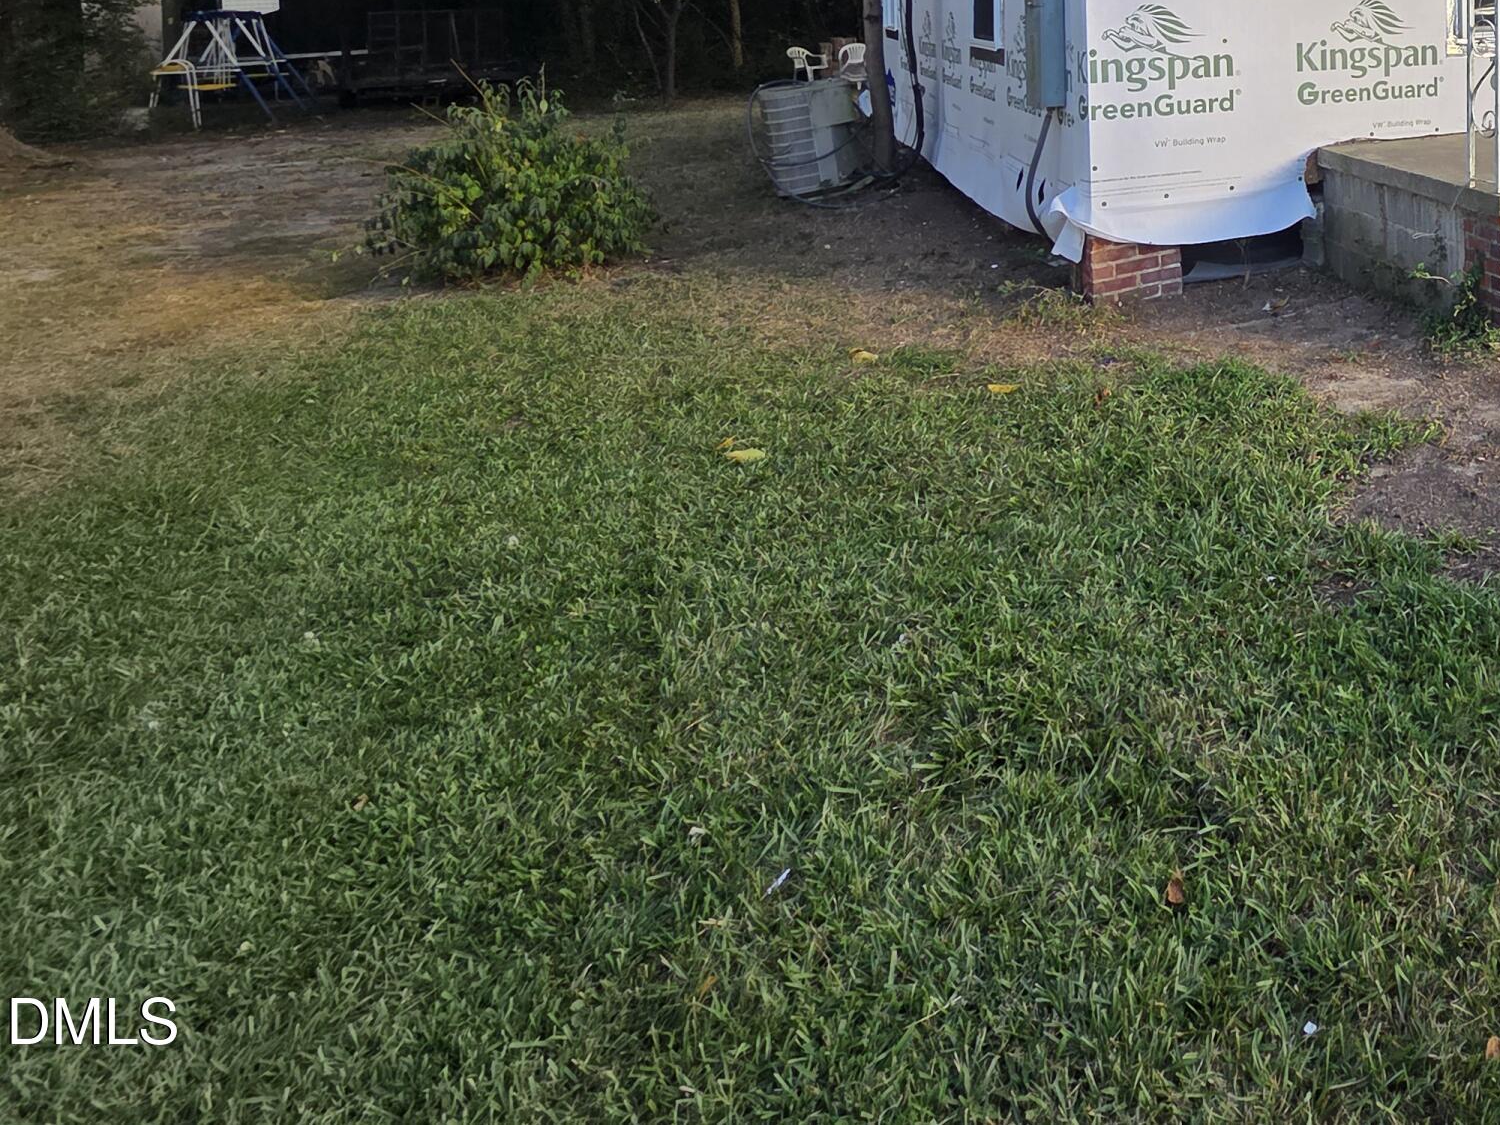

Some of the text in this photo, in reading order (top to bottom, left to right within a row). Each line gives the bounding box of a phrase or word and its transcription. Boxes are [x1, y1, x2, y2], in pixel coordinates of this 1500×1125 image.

[1077, 49, 1234, 92] Kingspan
[1296, 39, 1438, 79] Kingspan
[1078, 90, 1234, 121] GreenGuard
[1297, 77, 1438, 105] GreenGuard
[1172, 137, 1204, 148] Building
[1206, 135, 1226, 146] Wrap
